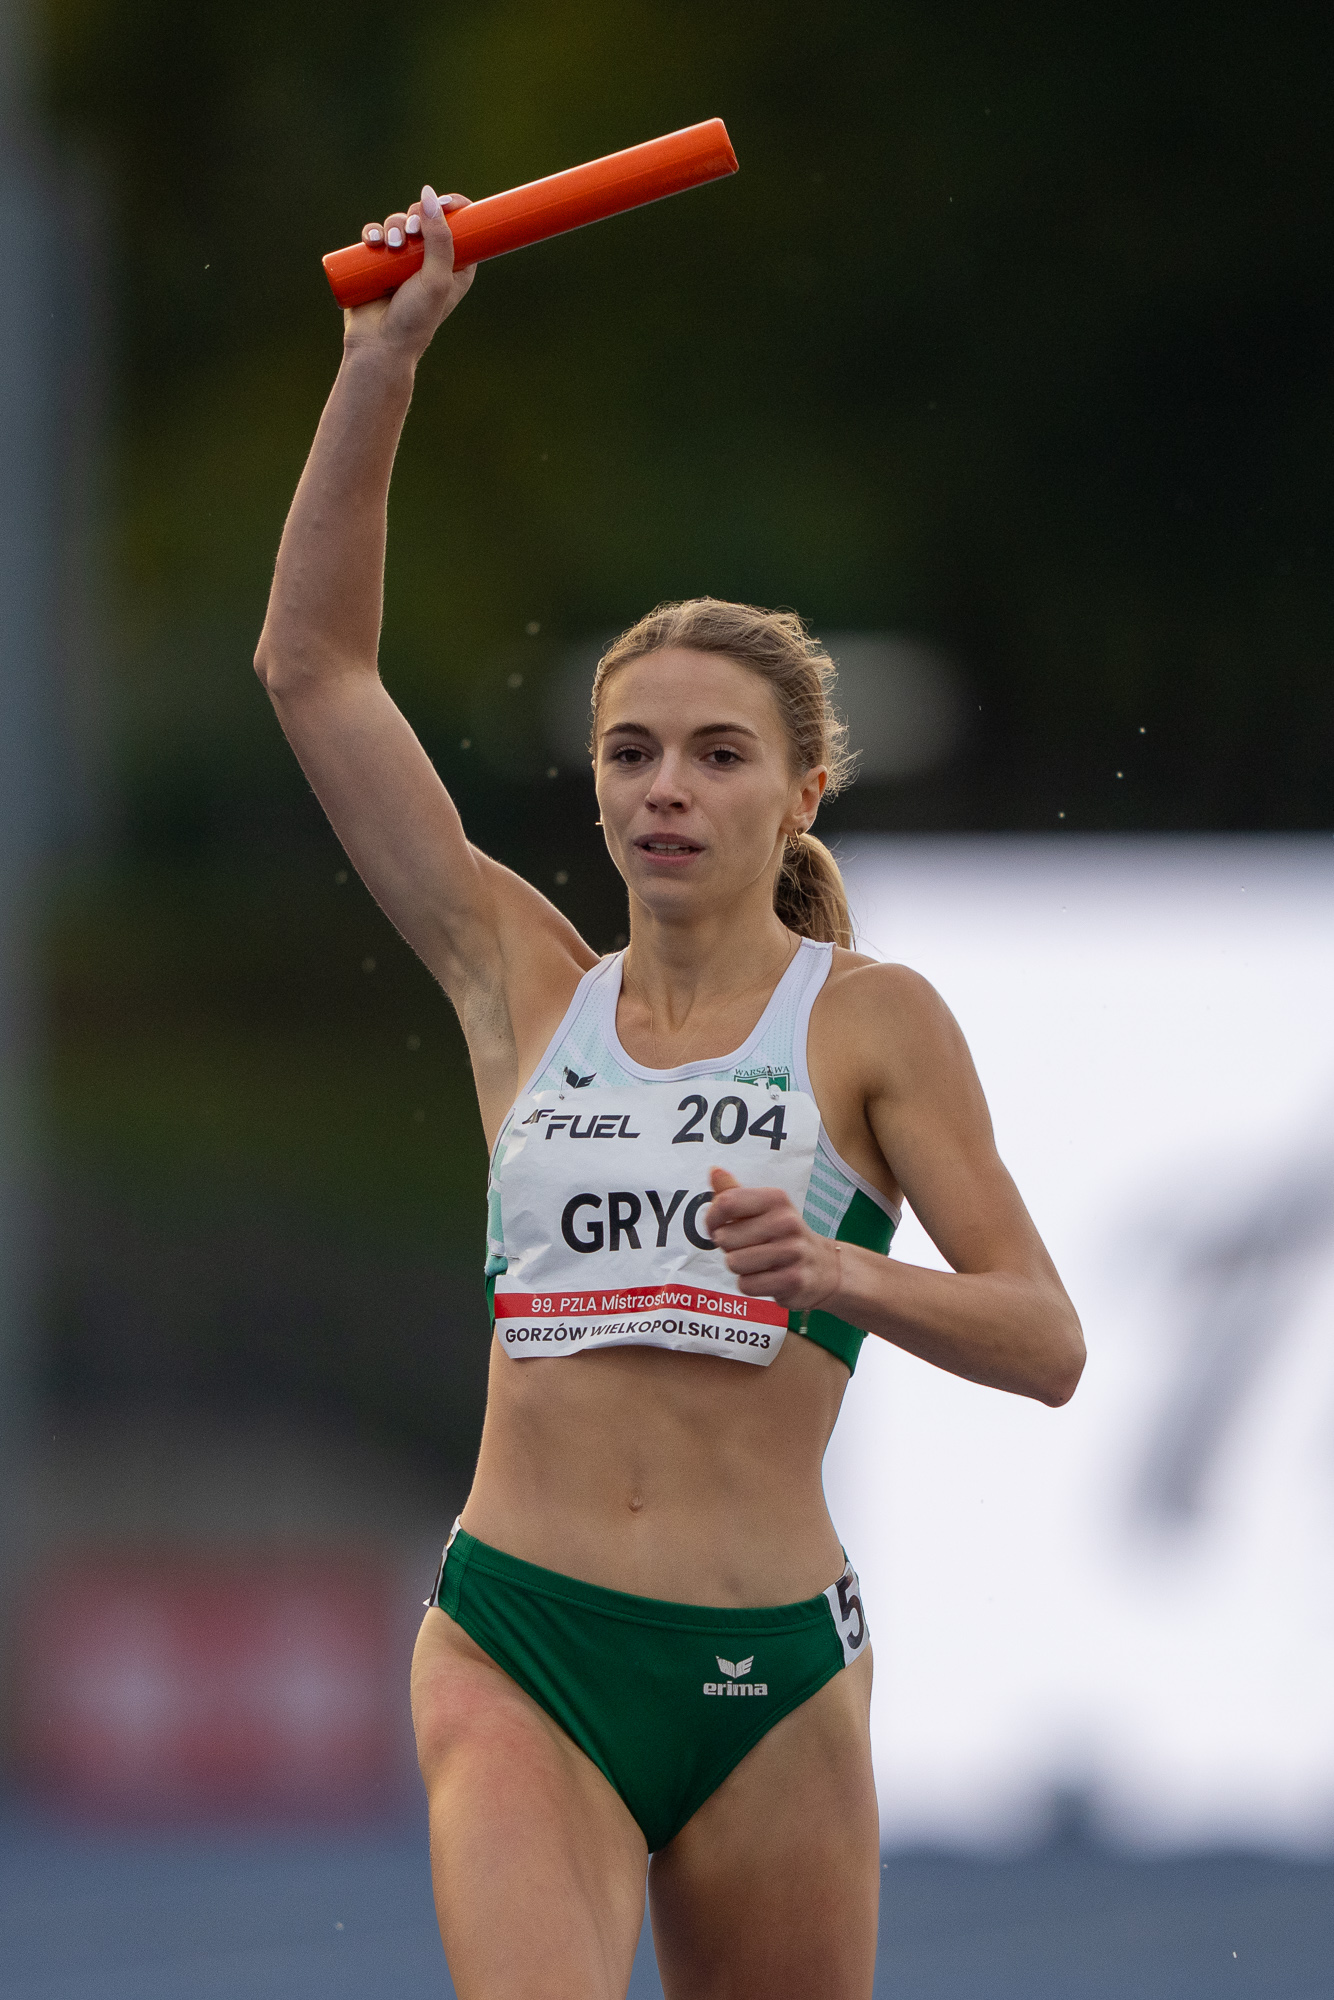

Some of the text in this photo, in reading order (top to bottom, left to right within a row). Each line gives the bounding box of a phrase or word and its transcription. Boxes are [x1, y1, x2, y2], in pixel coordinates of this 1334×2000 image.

[545, 1115, 641, 1140] FUEL
[672, 1094, 787, 1150] 204
[531, 1291, 748, 1316] 99. PZLA Mistrzostwa Polski
[505, 1319, 771, 1349] GORZÓW WIELKOPOLSKI 2023
[835, 1567, 864, 1650] 5
[703, 1681, 768, 1696] erima
